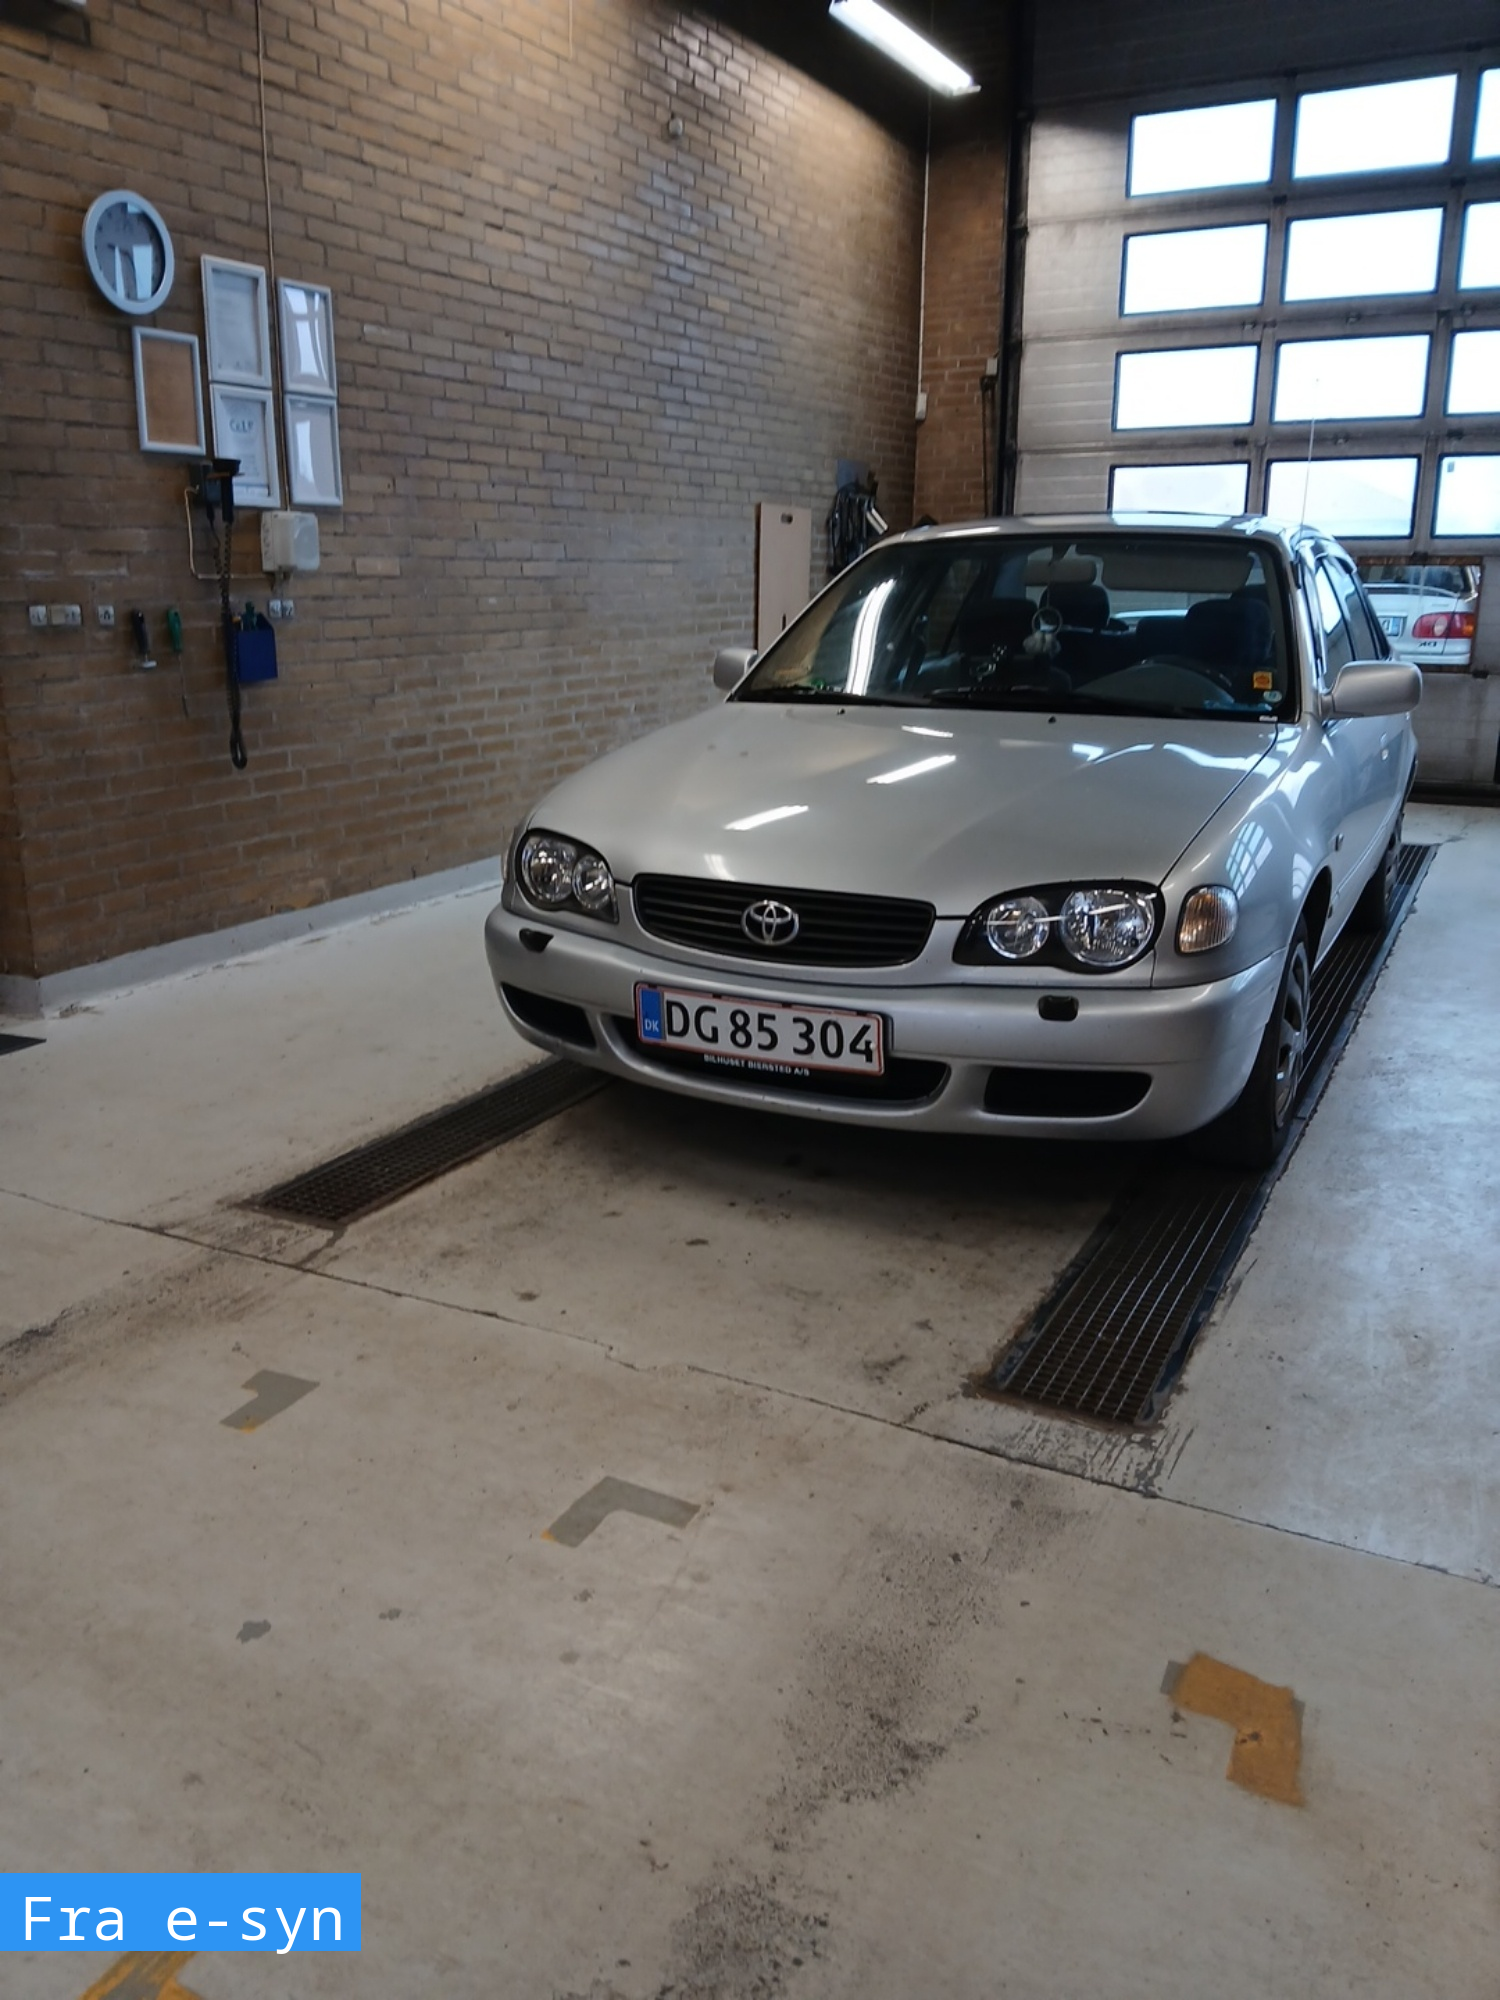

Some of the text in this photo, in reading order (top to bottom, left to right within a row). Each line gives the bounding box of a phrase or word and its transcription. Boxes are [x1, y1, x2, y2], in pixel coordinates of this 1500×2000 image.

[644, 1018, 659, 1033] DK
[665, 999, 874, 1064] DG 85 304
[703, 1053, 746, 1068] BILHUSET
